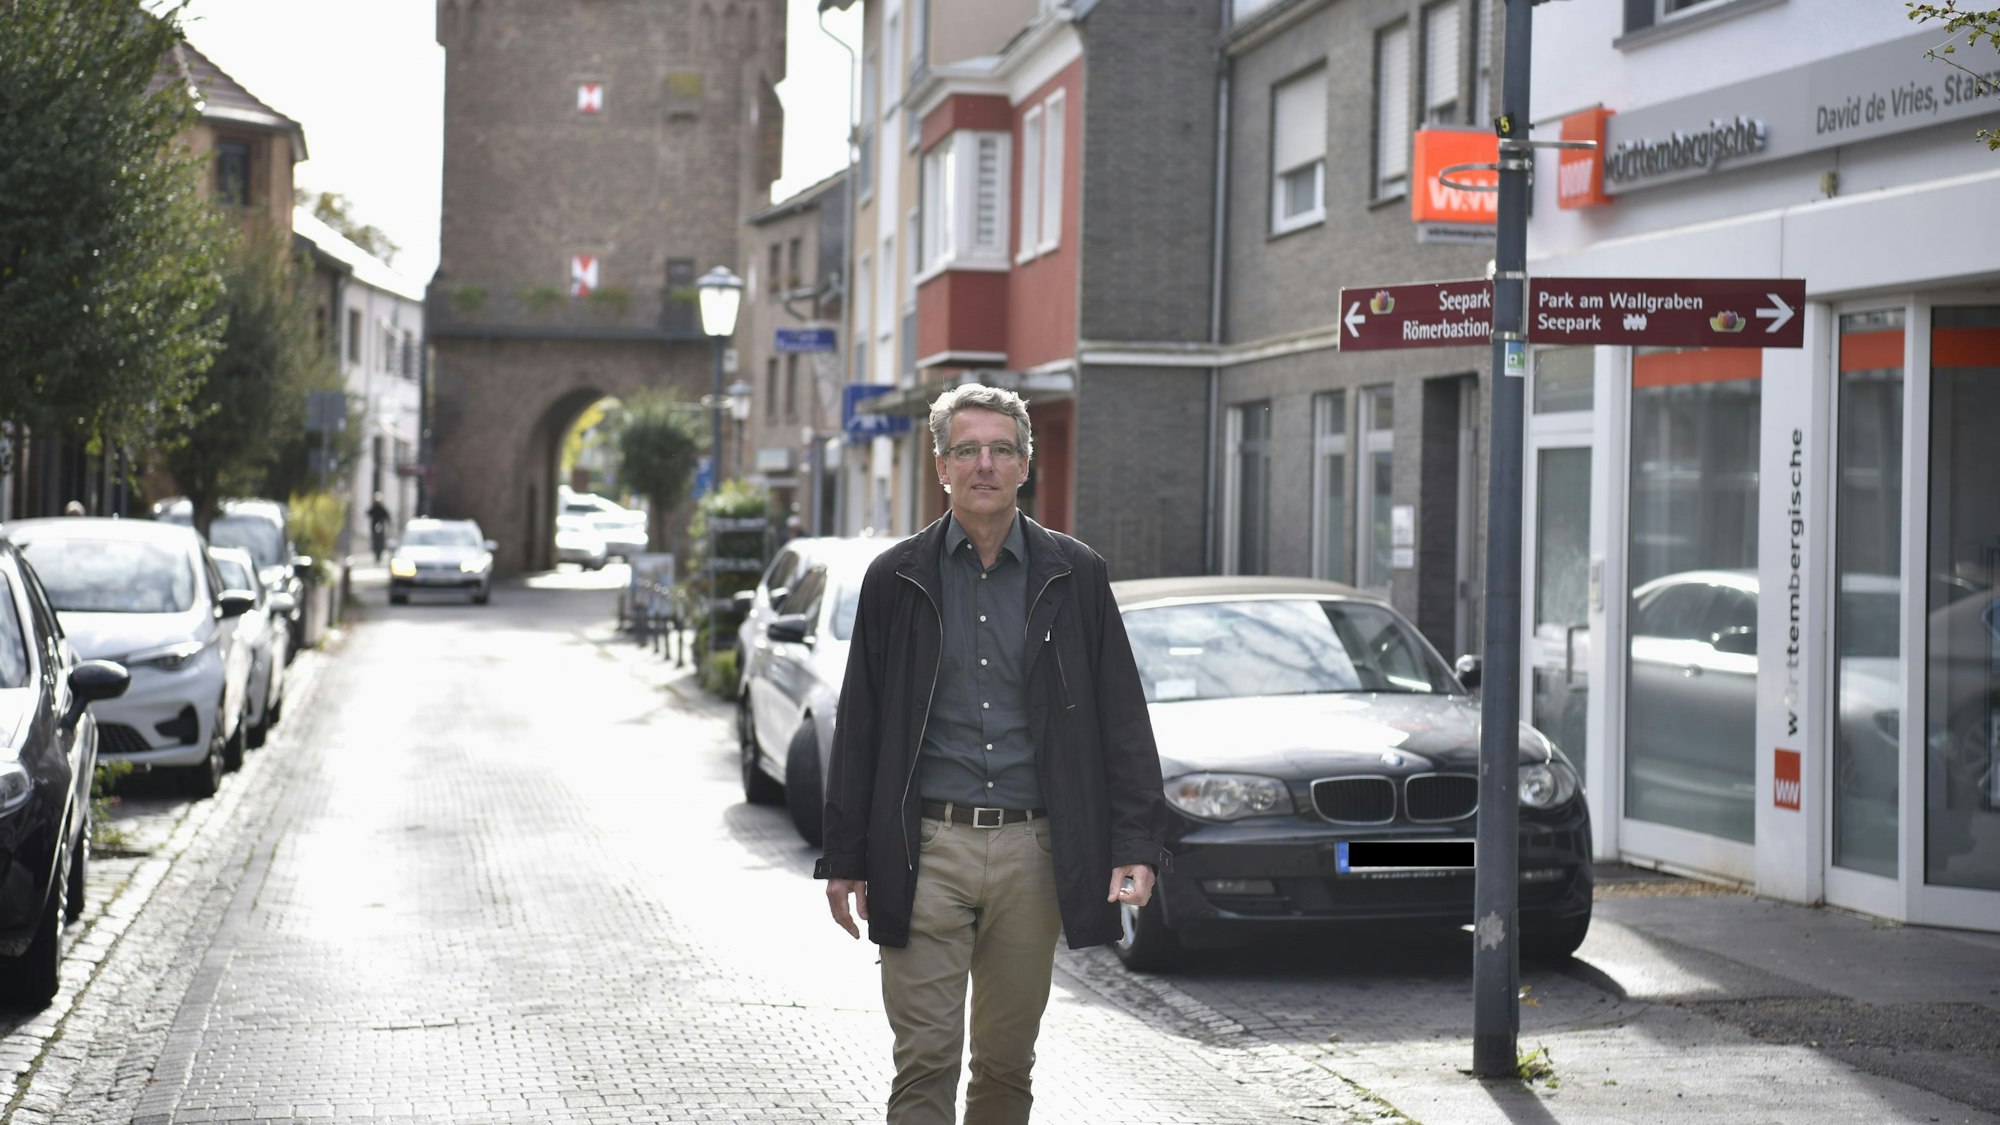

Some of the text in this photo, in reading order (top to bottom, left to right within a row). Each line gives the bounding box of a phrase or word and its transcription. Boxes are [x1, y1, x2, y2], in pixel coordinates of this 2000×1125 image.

[1816, 96, 1860, 135] David
[1865, 92, 1886, 124] de
[1891, 81, 1938, 118] Vries,
[1604, 114, 1766, 182] württembergische
[1439, 288, 1491, 315] Seepark
[1539, 291, 1703, 313] Park am Wallgraben
[1403, 317, 1490, 341] Römerbastion
[1537, 313, 1601, 334] Seepark
